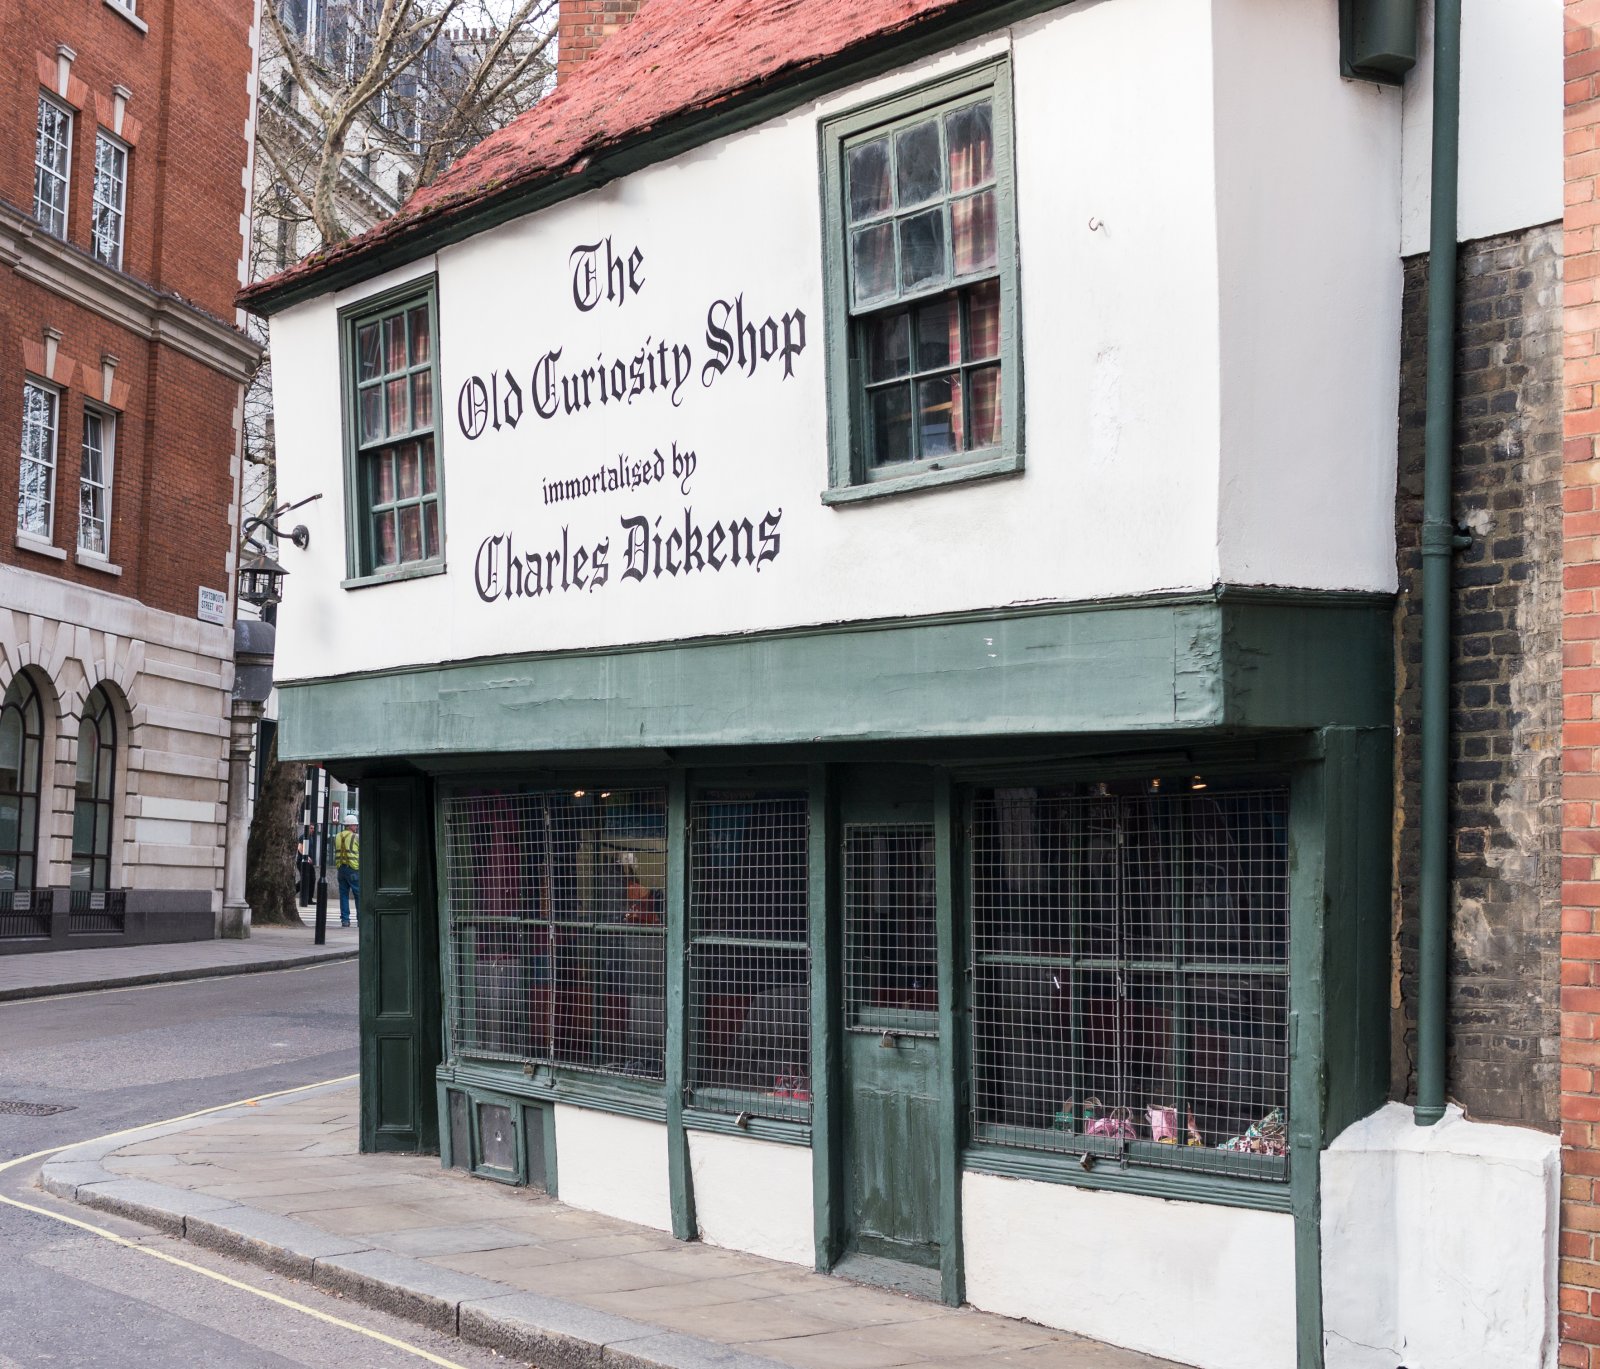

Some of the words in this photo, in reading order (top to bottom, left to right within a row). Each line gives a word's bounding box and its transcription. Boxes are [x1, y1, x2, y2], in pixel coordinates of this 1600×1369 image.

[569, 235, 646, 312] The
[458, 369, 524, 440] Old
[532, 336, 692, 419] Curiosity
[701, 292, 807, 388] Shop
[543, 448, 665, 505] immortalised
[671, 440, 697, 496] by
[474, 524, 610, 602] Charles
[620, 506, 783, 583] Dickens
[201, 600, 214, 611] STREET
[215, 604, 224, 613] WC2
